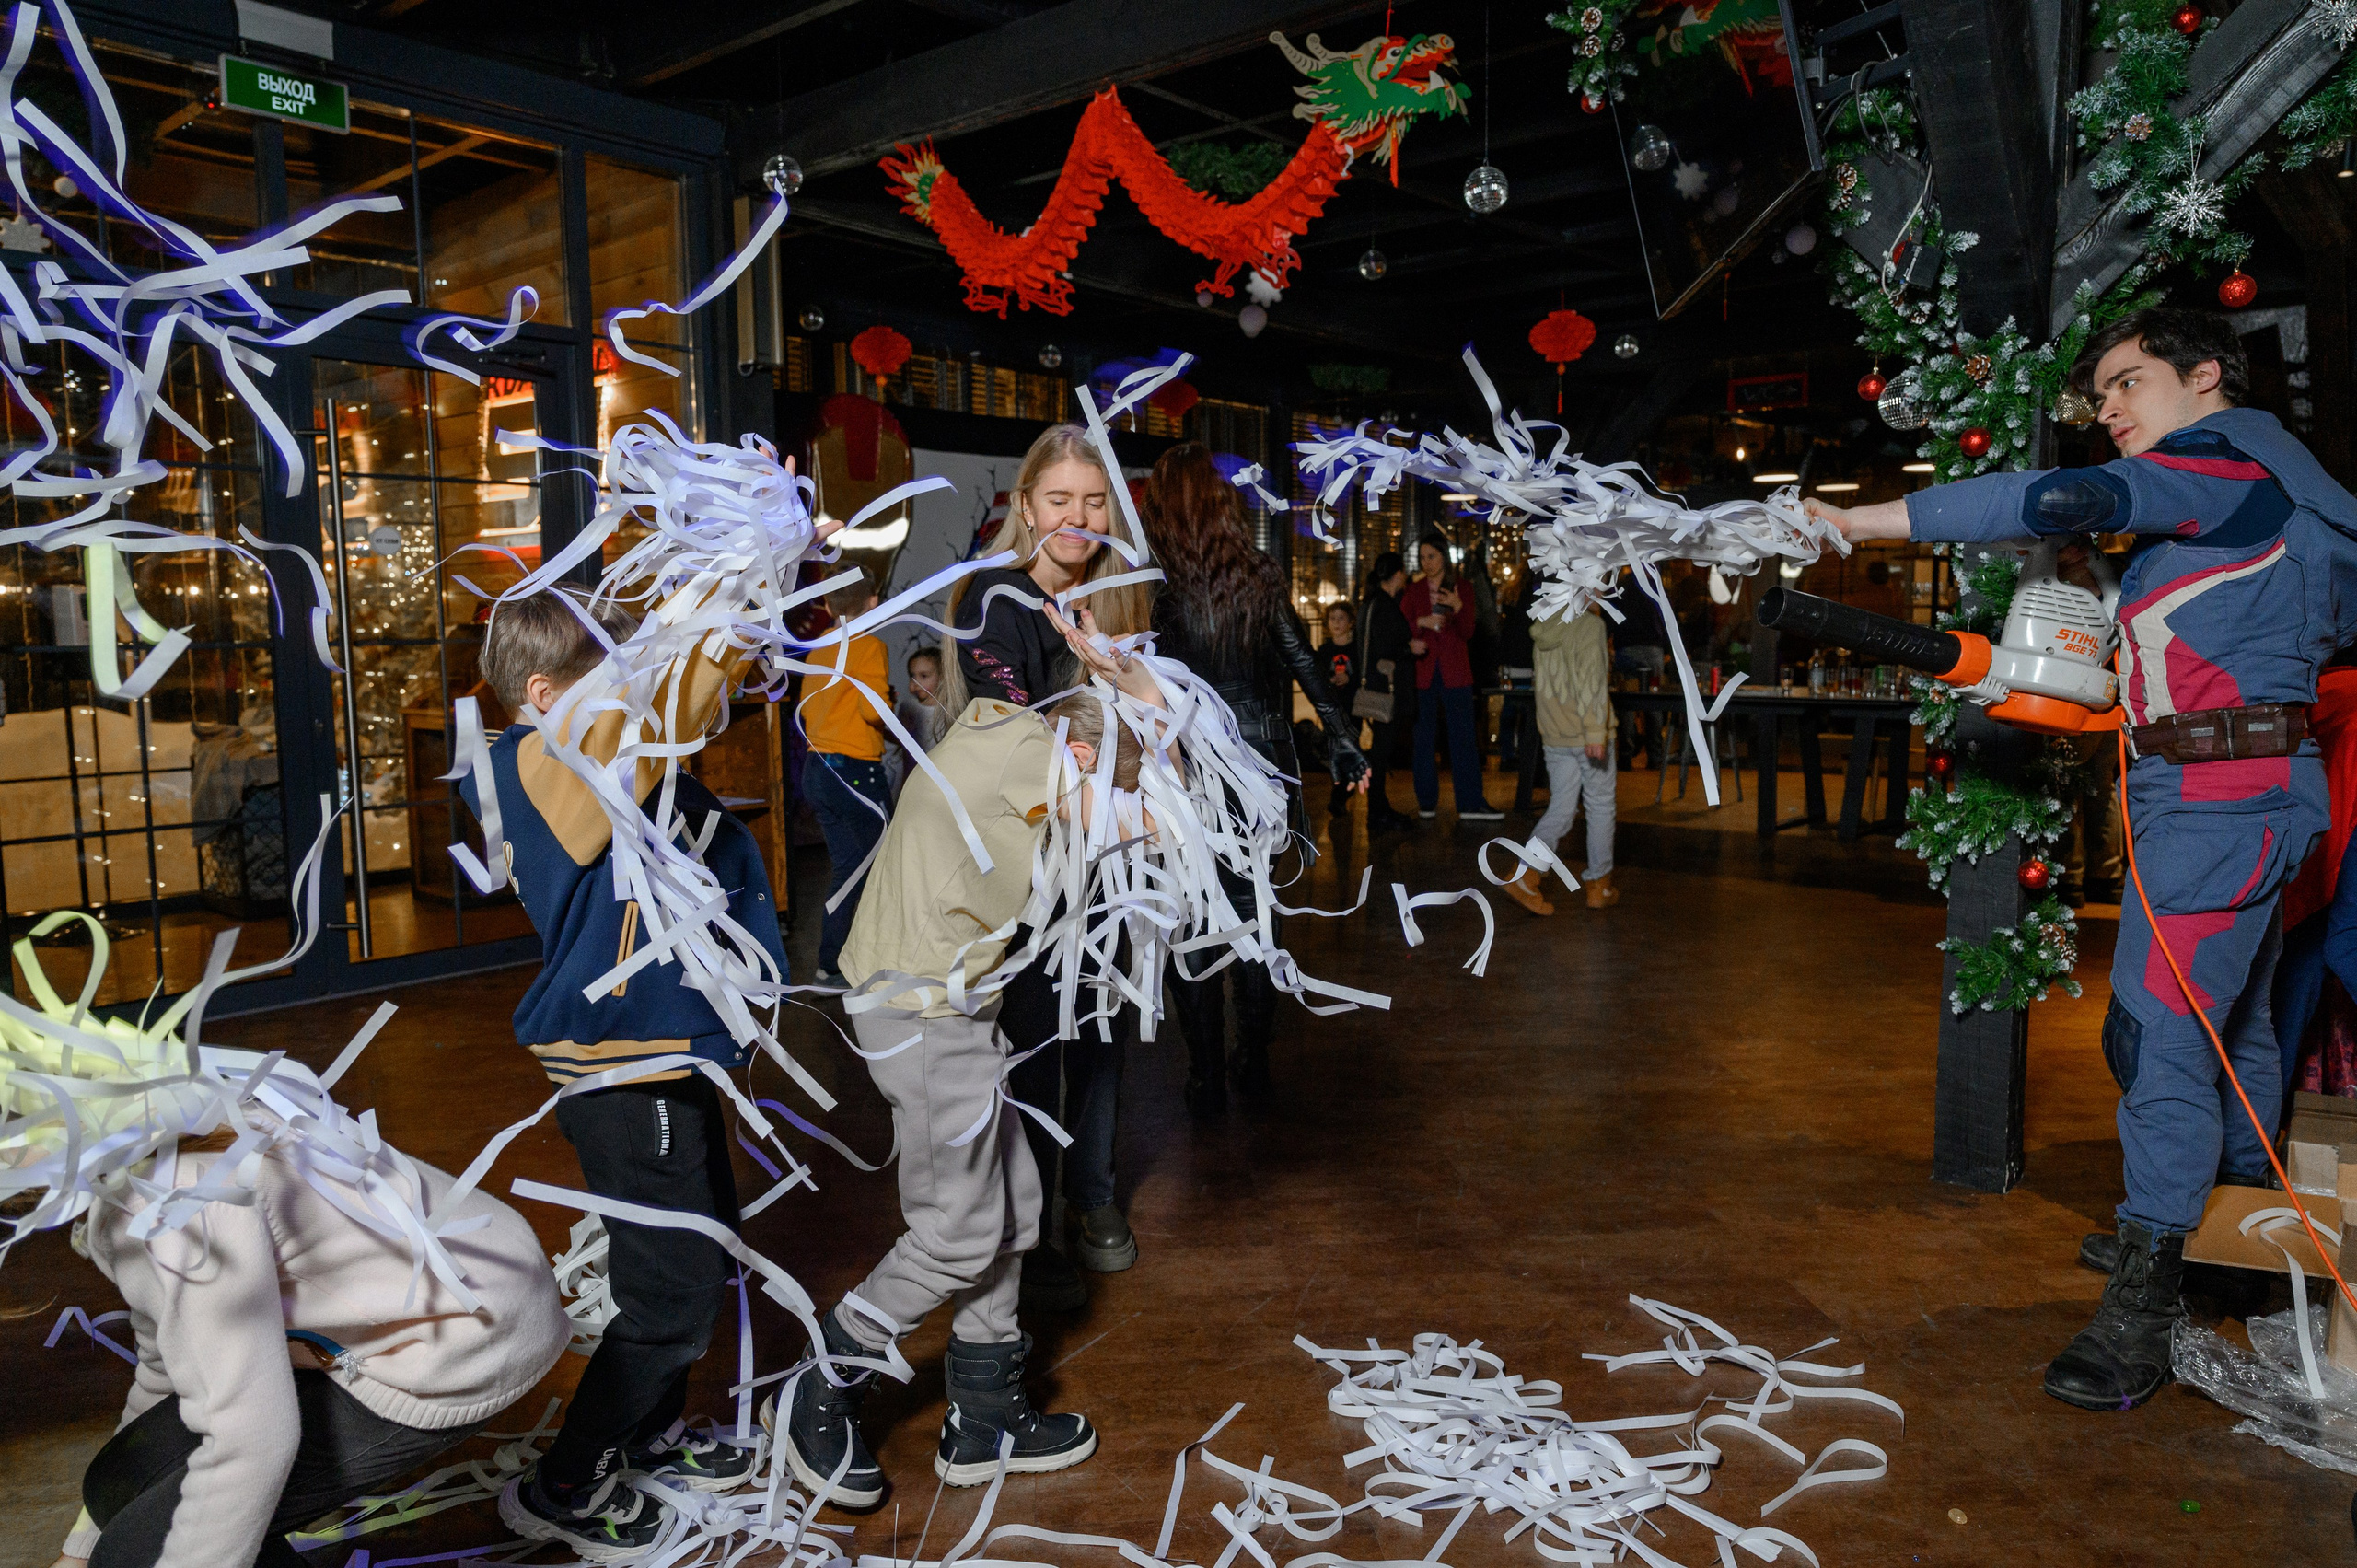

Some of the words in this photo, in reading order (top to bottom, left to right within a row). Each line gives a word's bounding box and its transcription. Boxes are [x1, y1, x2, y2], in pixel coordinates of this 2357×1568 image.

[258, 72, 316, 105] ВЫХОД
[272, 96, 307, 115] EXIT
[2055, 628, 2099, 650] STIHL
[2063, 643, 2087, 655] BGE
[2087, 648, 2097, 659] 71
